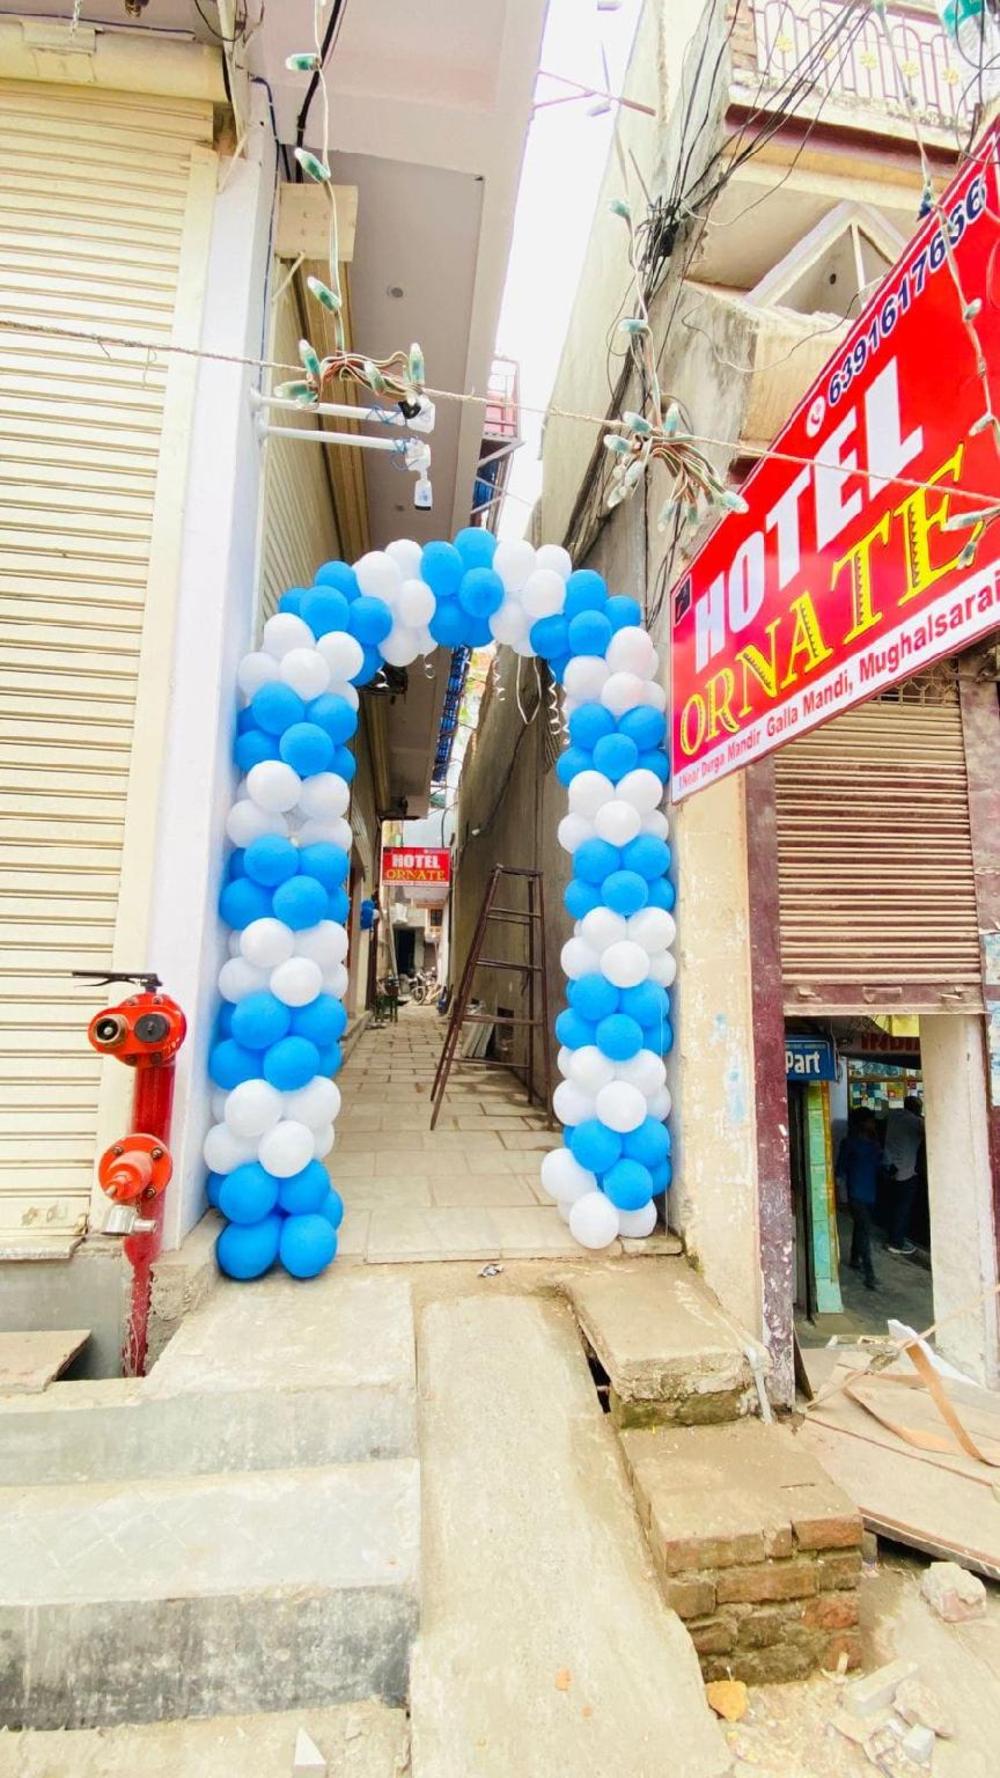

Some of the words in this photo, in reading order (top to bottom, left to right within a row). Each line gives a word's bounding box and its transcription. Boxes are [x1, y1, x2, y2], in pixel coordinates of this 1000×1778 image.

[695, 355, 924, 674] HOTEL
[680, 441, 983, 756] ORNATE
[727, 728, 761, 762] Mandir
[766, 706, 798, 737] Galla
[803, 670, 854, 717] Mandi,
[859, 569, 1000, 683] Mughalsarai
[386, 869, 446, 881] ORNATE
[391, 854, 441, 869] HOTEL
[785, 1050, 820, 1075] Part
